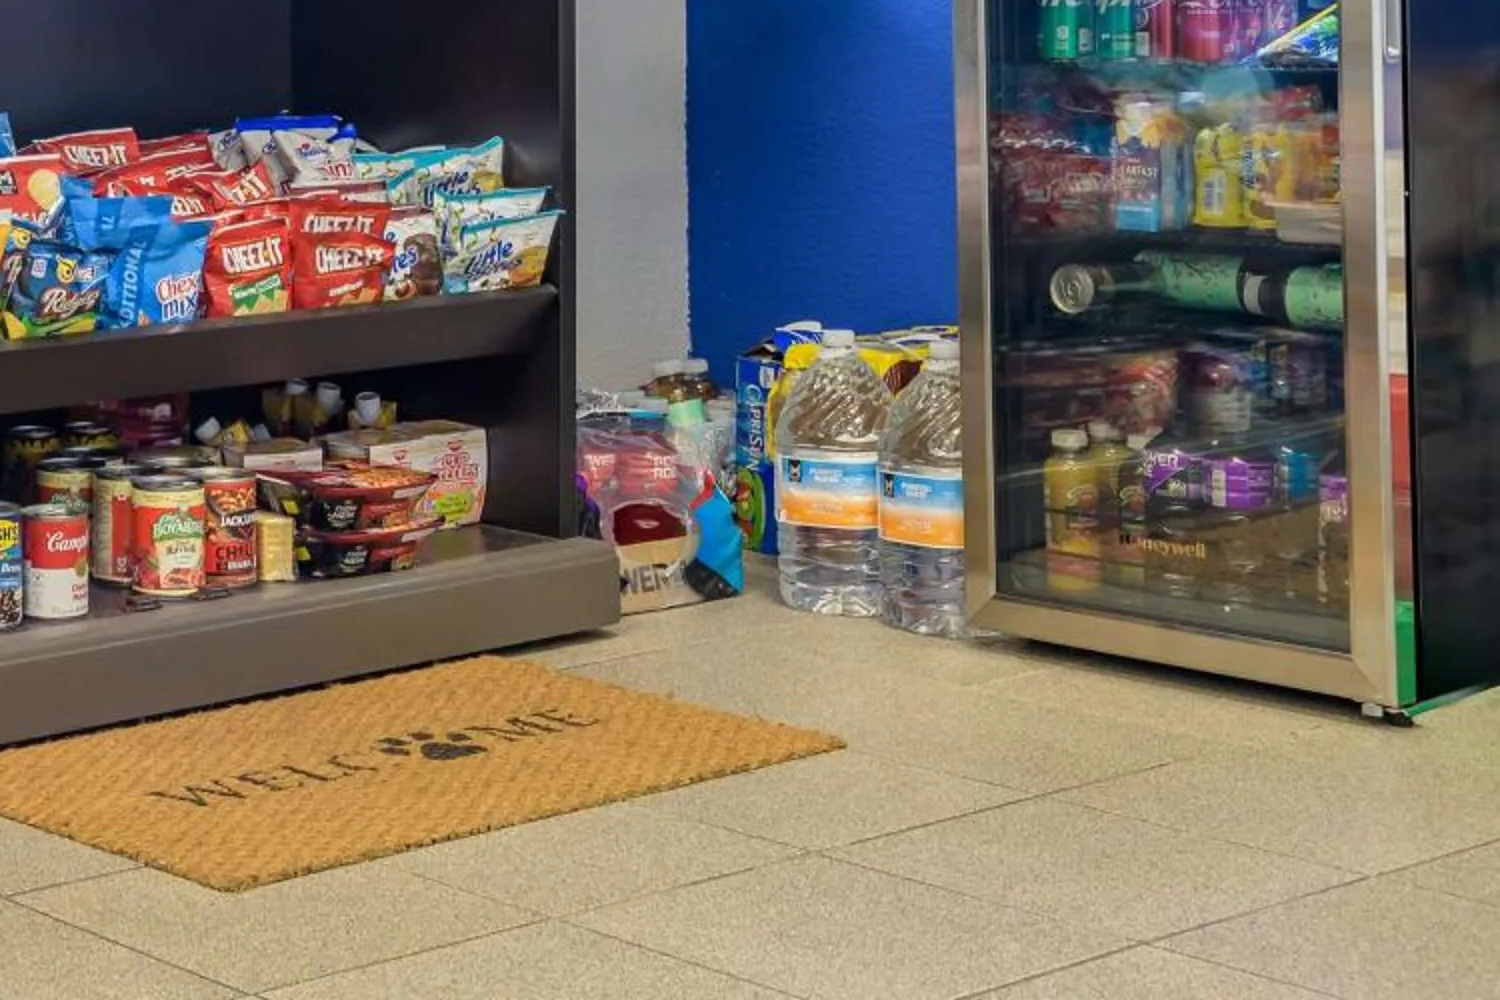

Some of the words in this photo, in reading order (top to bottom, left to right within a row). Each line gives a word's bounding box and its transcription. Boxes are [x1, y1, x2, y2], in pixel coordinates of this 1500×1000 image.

[222, 236, 284, 275] CHEEZ-IT
[156, 274, 199, 301] Chex
[148, 708, 600, 808] WELCME
